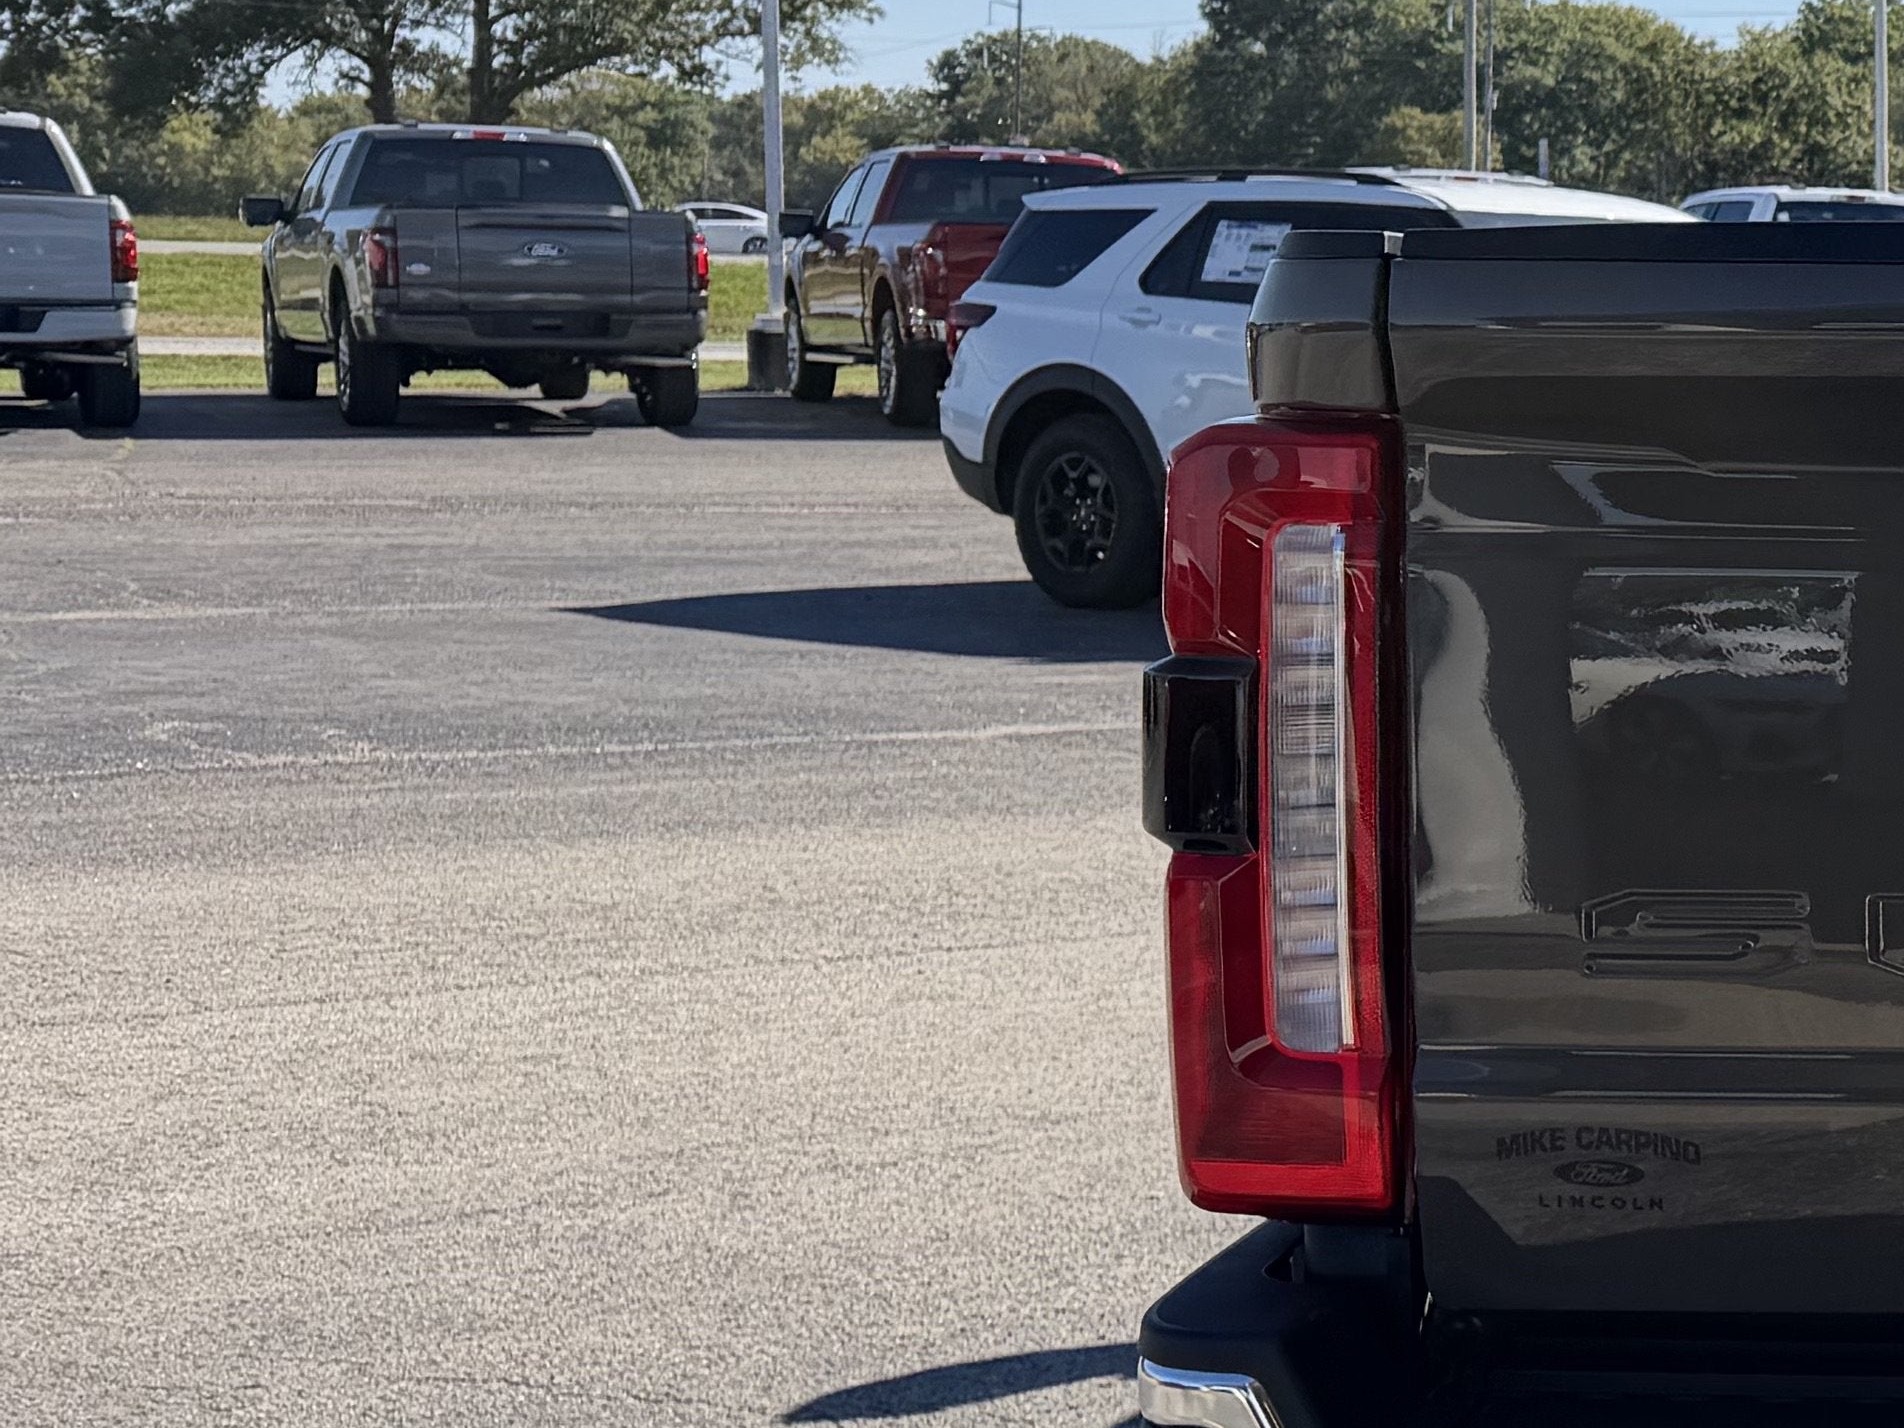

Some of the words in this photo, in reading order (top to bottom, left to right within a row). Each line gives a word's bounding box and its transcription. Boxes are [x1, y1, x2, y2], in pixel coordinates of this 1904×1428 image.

[1496, 1128, 1566, 1162] MIKE
[1575, 1126, 1700, 1165] CARPINO
[1570, 1162, 1630, 1184] Ford
[1539, 1194, 1664, 1211] LINCOLN
